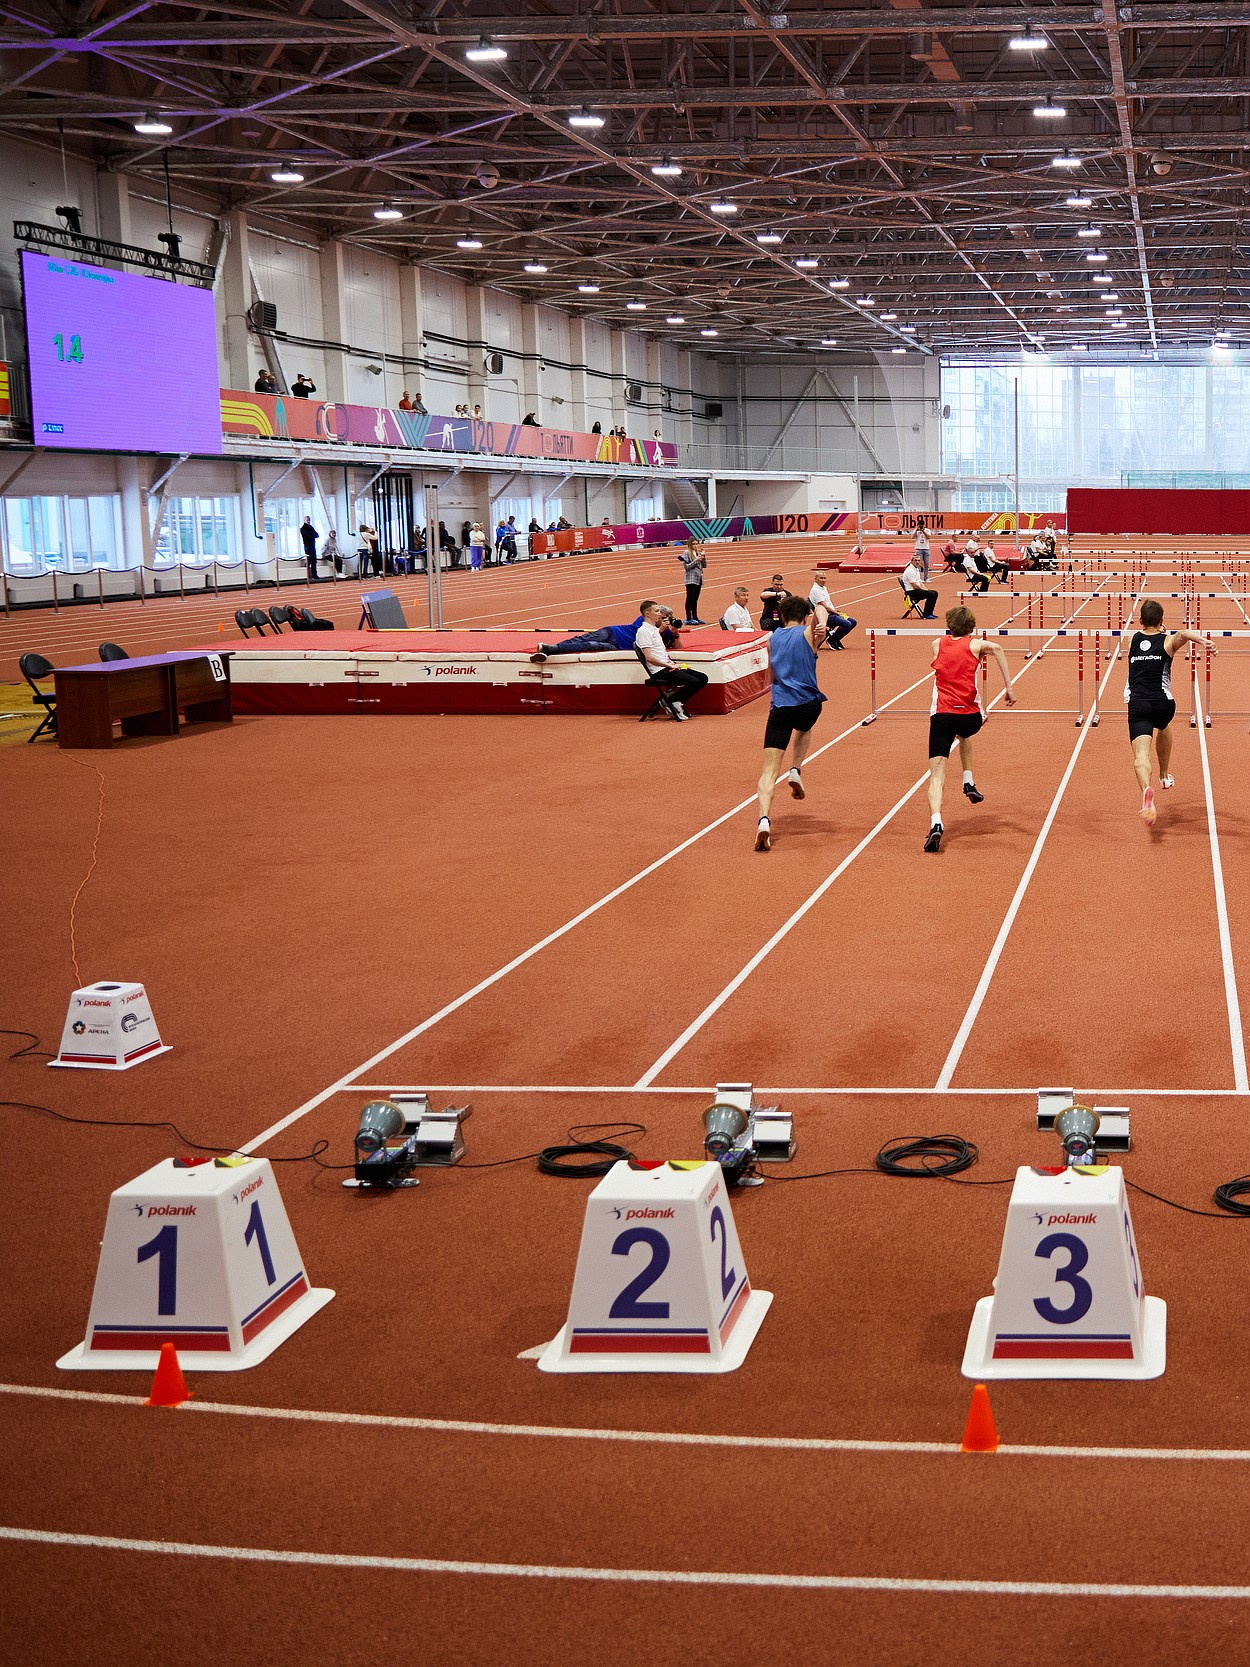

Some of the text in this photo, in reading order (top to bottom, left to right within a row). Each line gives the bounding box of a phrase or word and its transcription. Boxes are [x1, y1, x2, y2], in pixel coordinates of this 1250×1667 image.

[53, 332, 84, 364] 1.4
[771, 514, 808, 533] U20
[435, 665, 477, 677] polanik
[83, 999, 112, 1008] polanik
[240, 1175, 264, 1200] polanik
[147, 1205, 197, 1218] polanik
[626, 1207, 676, 1221] polanik
[1047, 1212, 1097, 1227] polanik
[244, 1200, 277, 1287] 1
[710, 1205, 737, 1302] 2
[137, 1225, 178, 1316] 1
[608, 1226, 671, 1319] 2
[1033, 1232, 1093, 1325] 3
